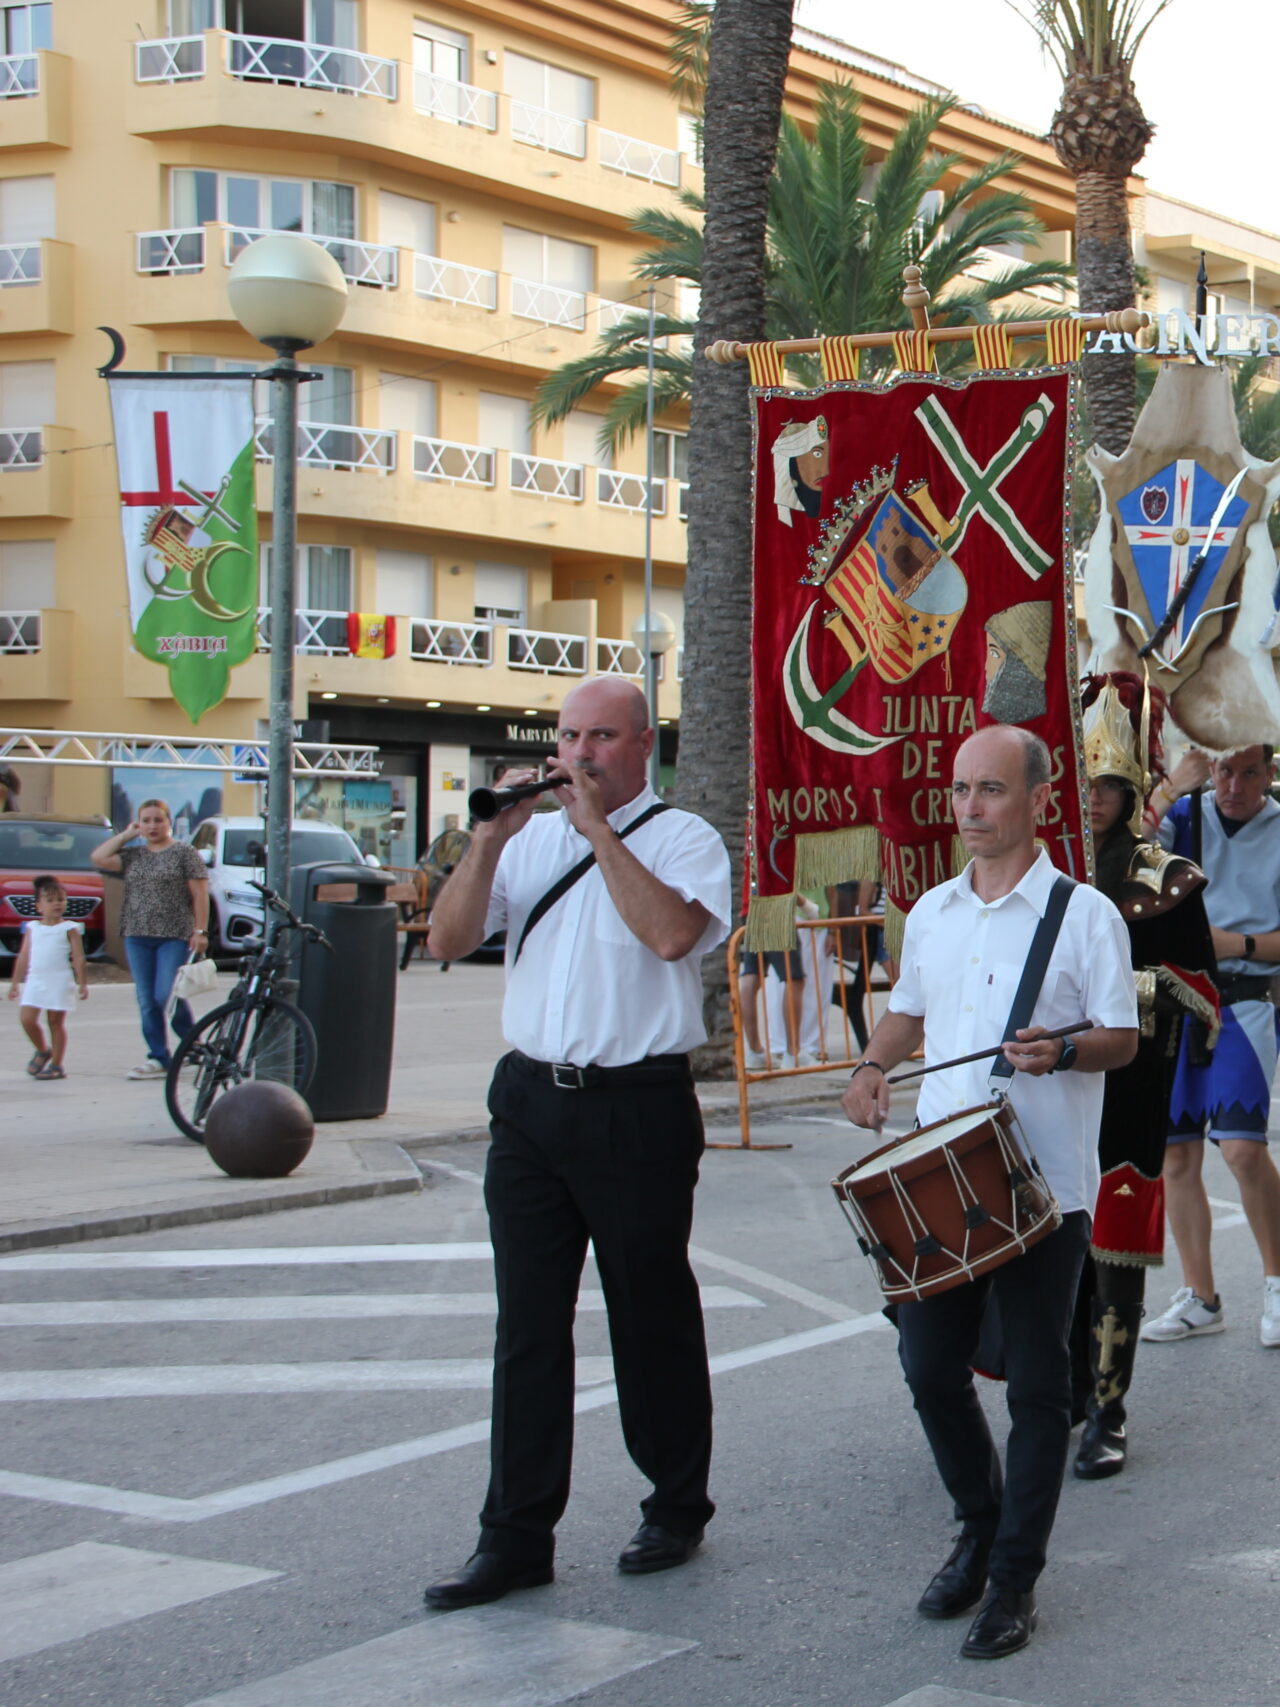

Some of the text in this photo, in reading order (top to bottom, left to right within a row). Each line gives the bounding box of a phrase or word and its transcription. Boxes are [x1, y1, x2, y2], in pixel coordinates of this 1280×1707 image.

[881, 695, 977, 733] JUNTA
[902, 740, 943, 779] DE
[767, 785, 858, 823] MOROS
